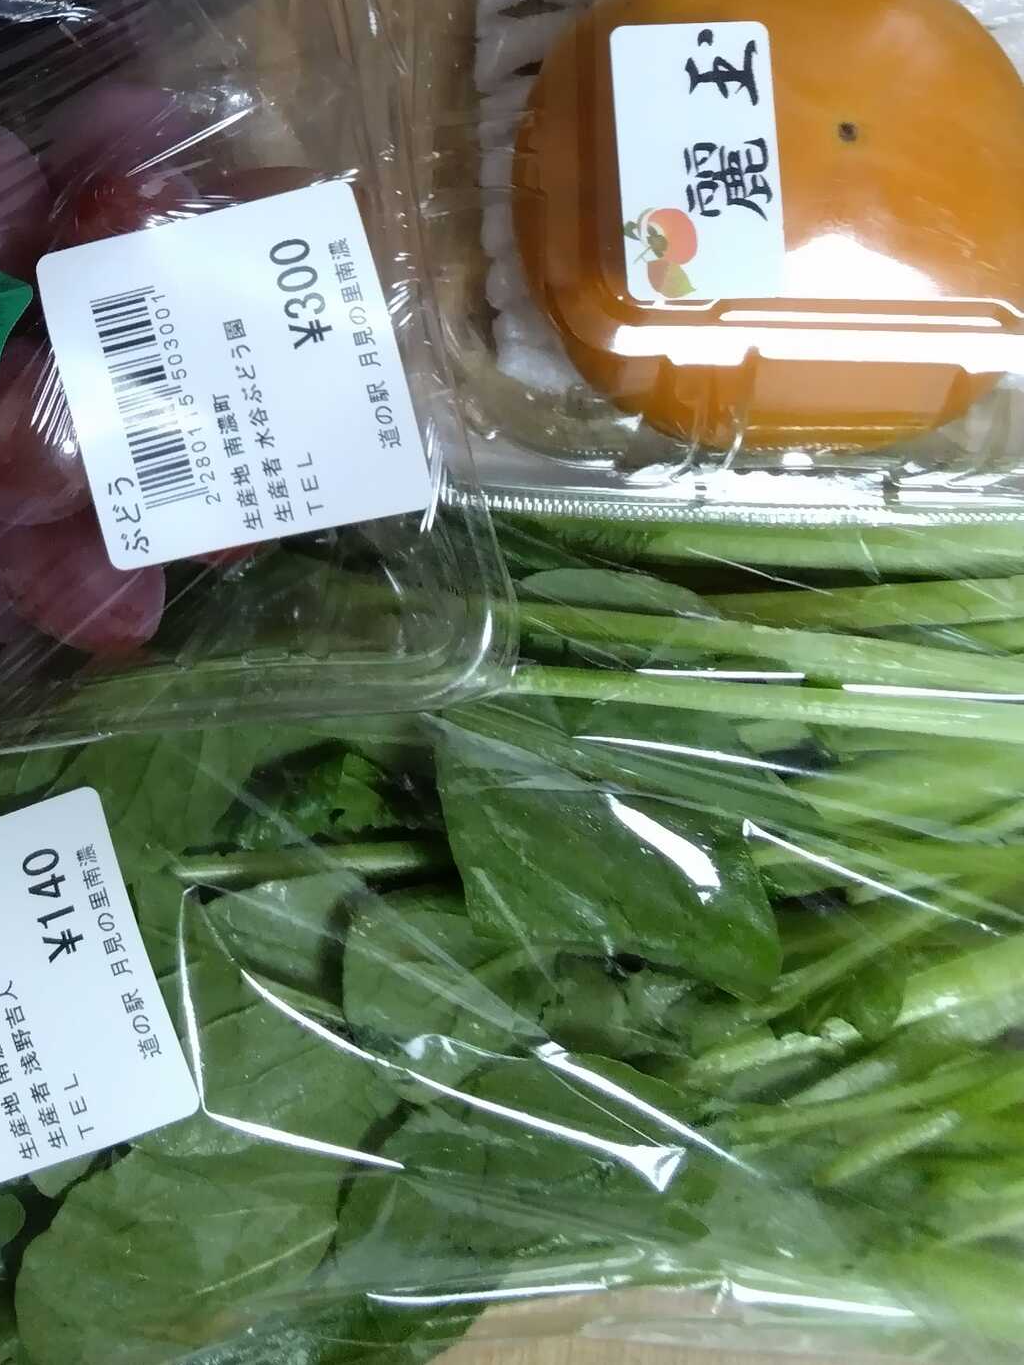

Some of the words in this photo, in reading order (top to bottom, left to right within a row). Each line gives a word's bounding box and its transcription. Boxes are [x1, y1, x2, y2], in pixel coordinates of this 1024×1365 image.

[685, 28, 772, 222] 麗玉
[269, 238, 333, 350] ¥300
[327, 237, 382, 368] 月見の里南濃
[152, 293, 188, 380] 503001
[223, 318, 277, 450] 水谷ぶどう園
[365, 381, 402, 450] 道の駅
[212, 394, 244, 458] 南濃町
[107, 476, 150, 554] ぶどう
[228, 464, 263, 530] 生産地
[261, 457, 295, 524] 生産者
[297, 452, 325, 515] TEL
[22, 847, 84, 964] ¥140
[76, 843, 134, 977] 月見の里南濃
[121, 986, 163, 1060] 道の駅
[1, 1091, 40, 1162] 生産地
[31, 1081, 69, 1150] 生産者
[64, 1072, 96, 1140] TEL
